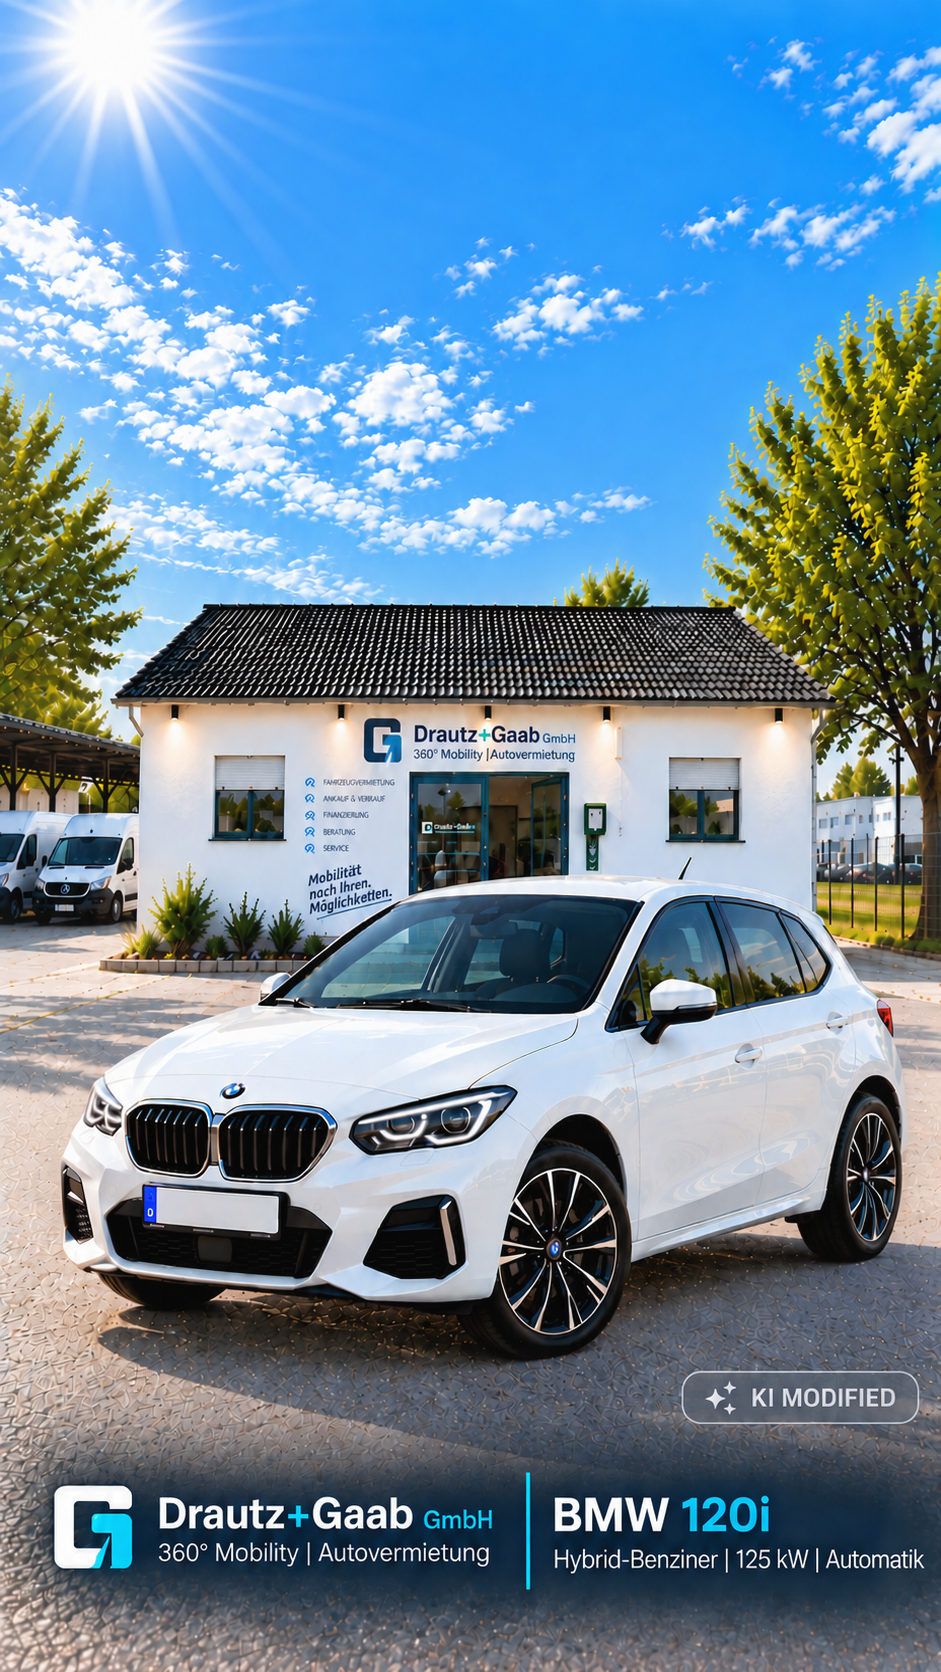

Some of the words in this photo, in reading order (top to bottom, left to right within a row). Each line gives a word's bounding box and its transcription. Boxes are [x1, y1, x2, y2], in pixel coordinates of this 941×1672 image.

[414, 725, 540, 743] Drautz+Gaab
[542, 733, 576, 744] GmbH
[413, 749, 438, 760] 360°
[440, 749, 484, 761] Mobility
[309, 884, 337, 900] nach
[340, 880, 371, 893] Ihren.
